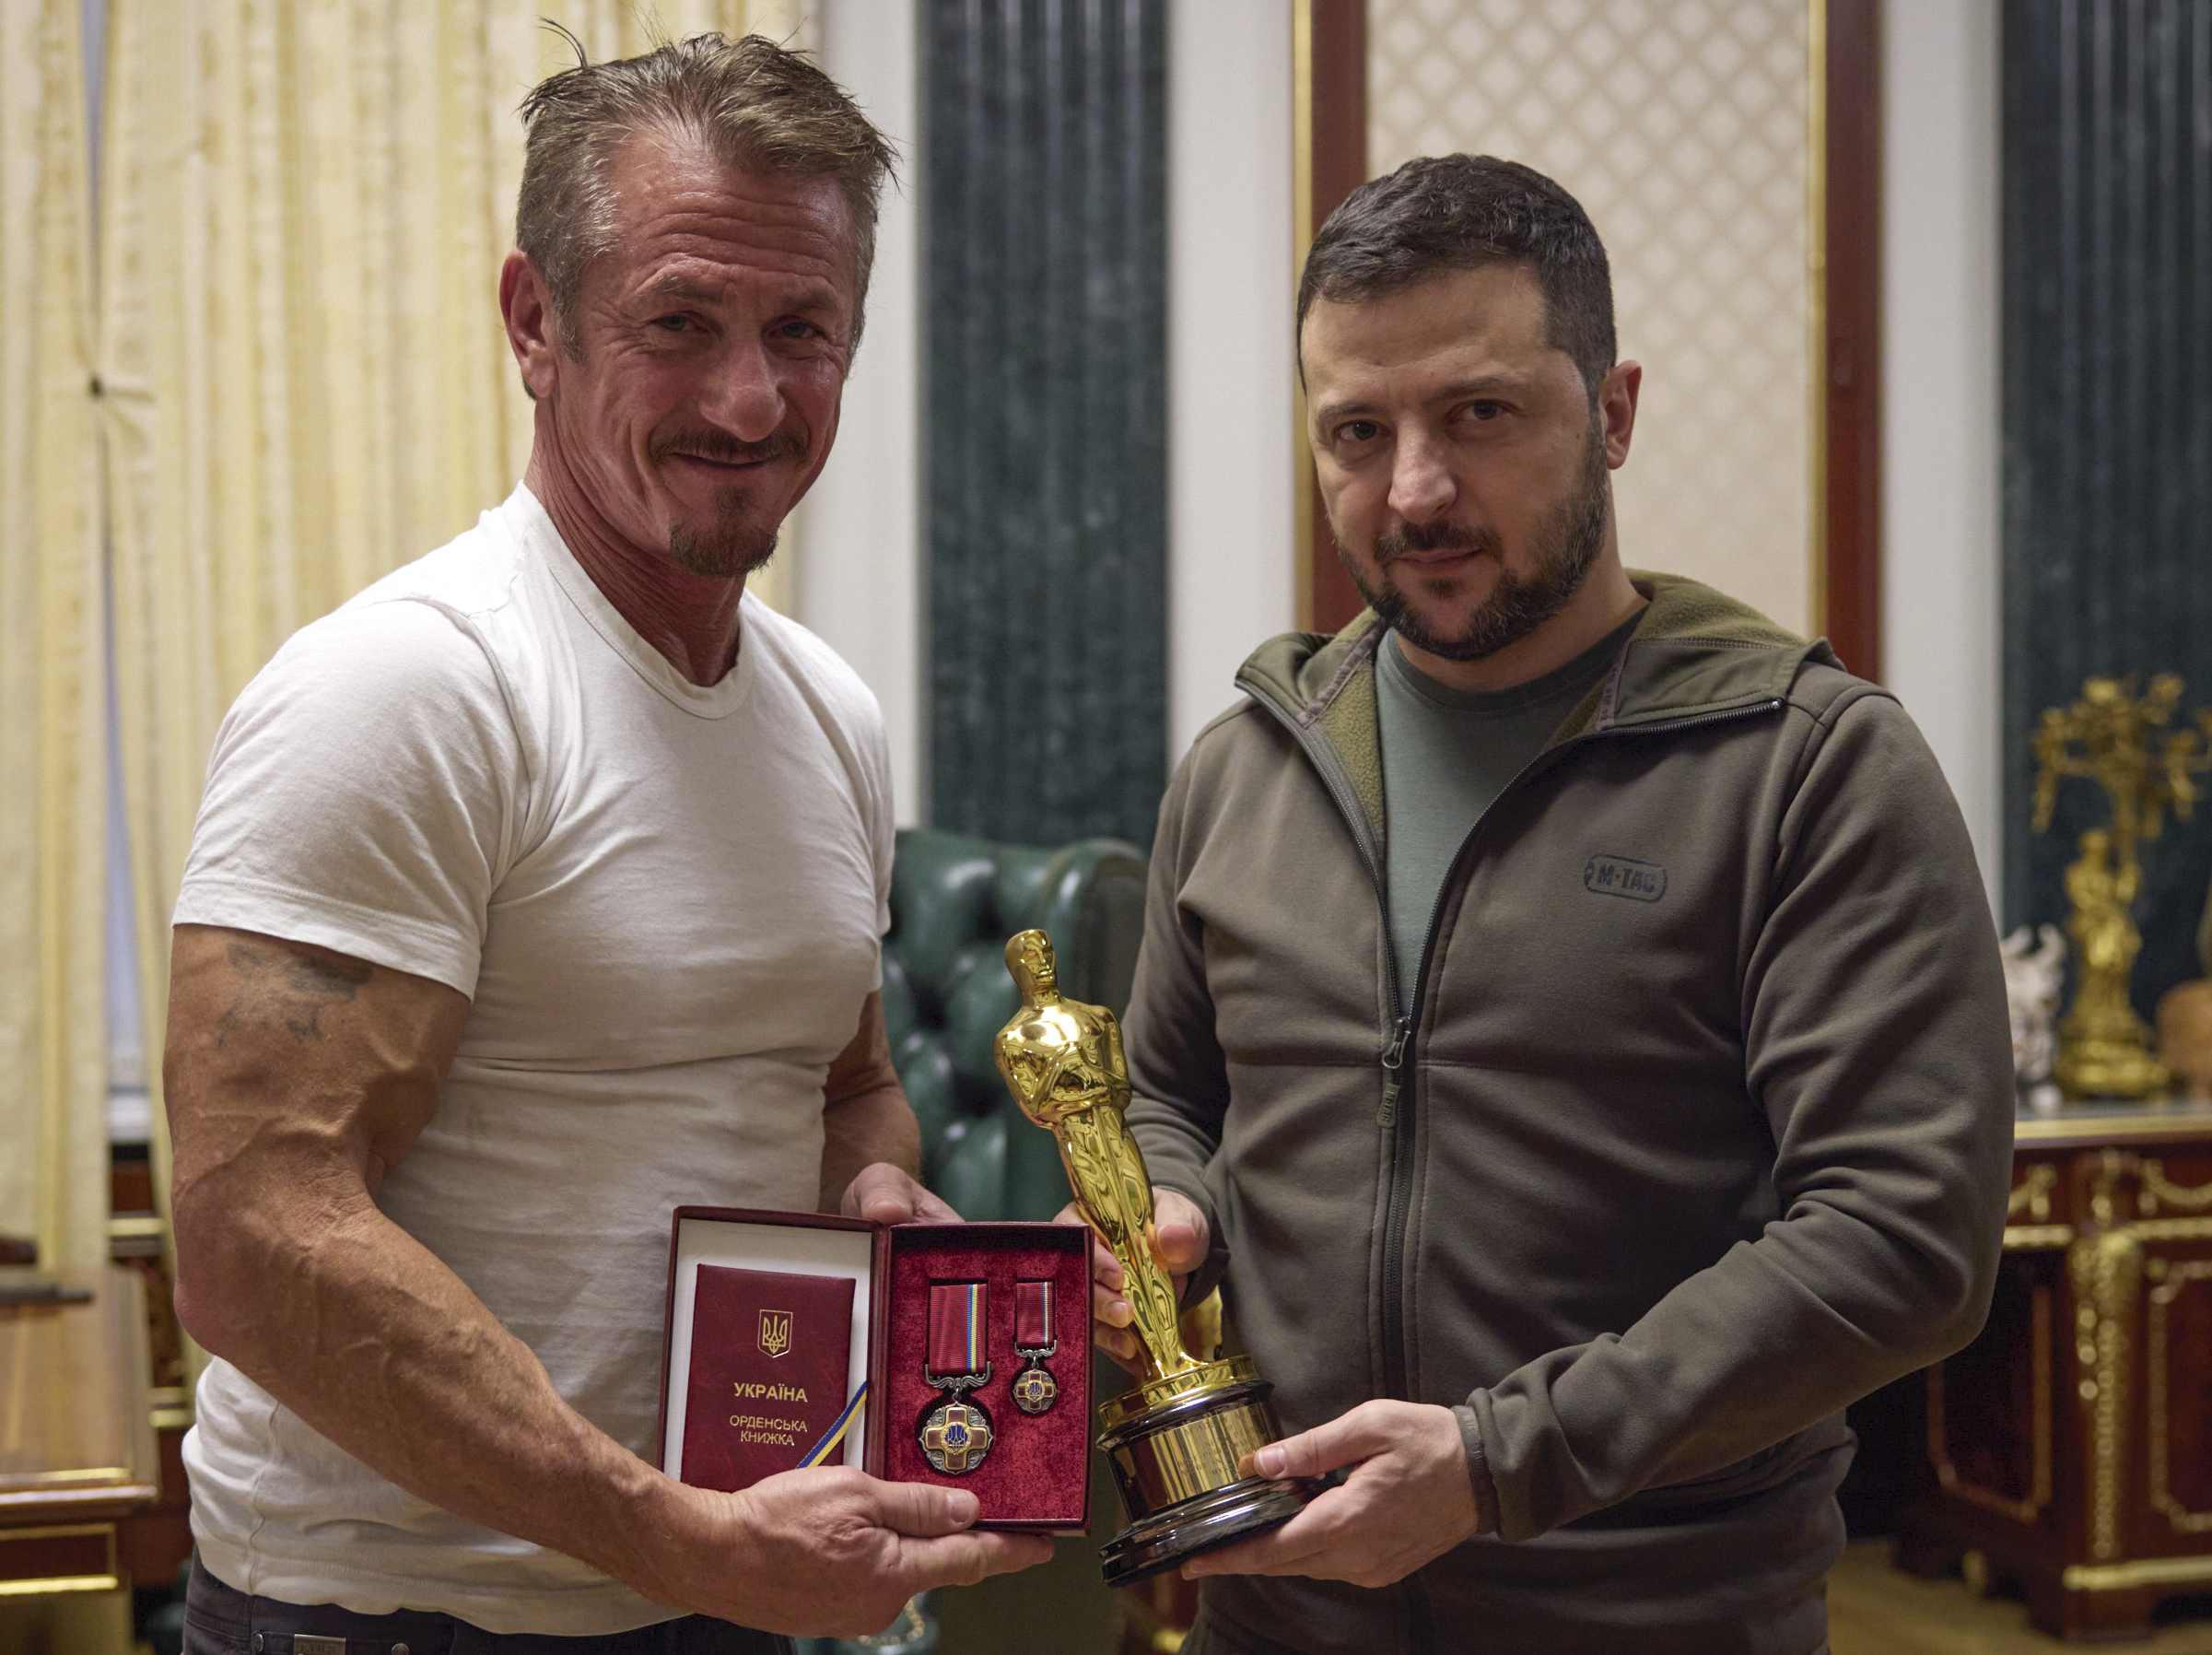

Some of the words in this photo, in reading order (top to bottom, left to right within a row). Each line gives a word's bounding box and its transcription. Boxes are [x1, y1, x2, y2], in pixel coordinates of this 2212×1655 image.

[733, 1382, 808, 1403] УКРАЇНА
[730, 1414, 807, 1432] ОРДЕНСЬКА
[740, 1430, 795, 1446] КНИЖКА
